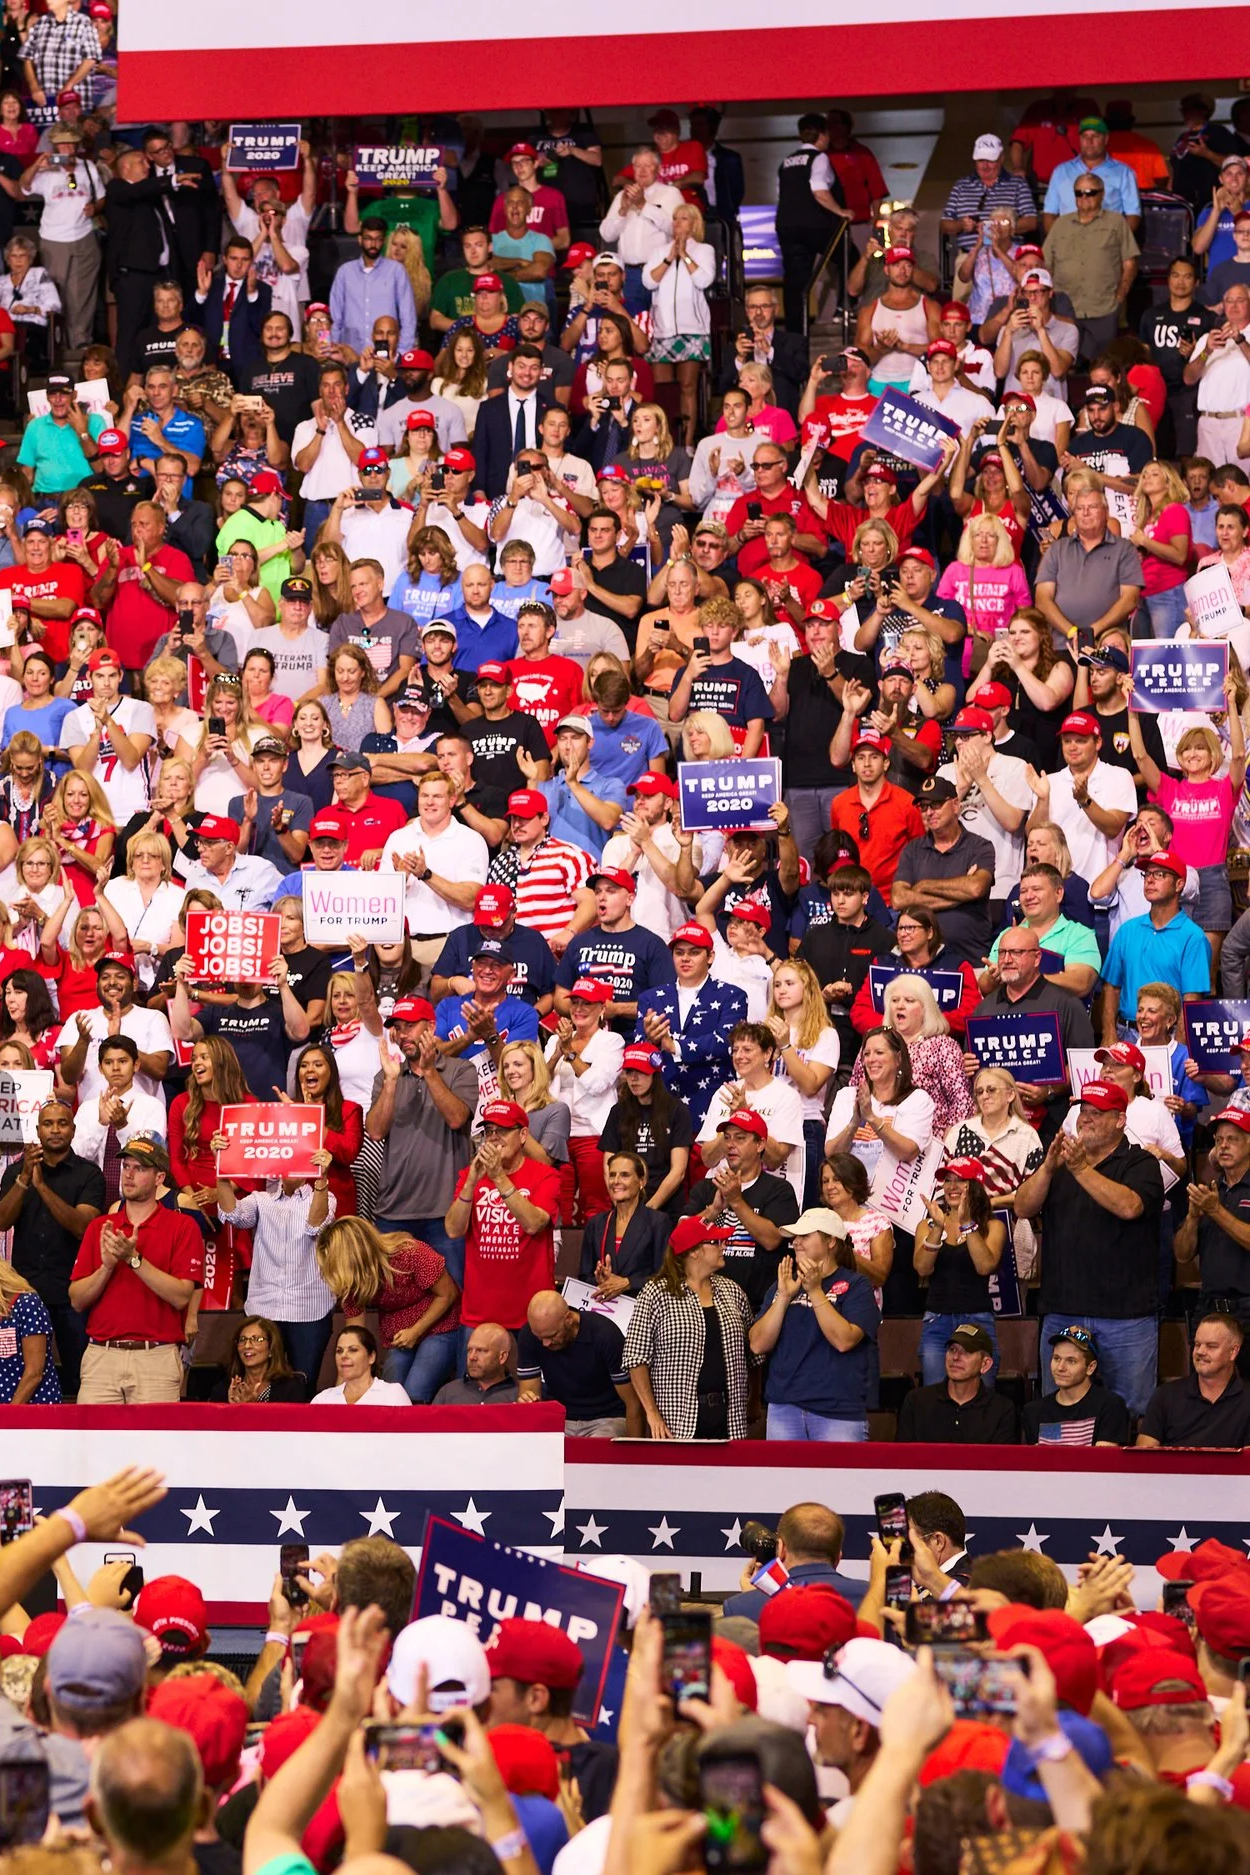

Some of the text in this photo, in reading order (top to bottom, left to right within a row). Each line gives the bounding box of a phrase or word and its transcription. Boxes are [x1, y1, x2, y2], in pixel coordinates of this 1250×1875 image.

[26, 106, 59, 116] TRU
[234, 136, 297, 147] TRUMP
[246, 151, 281, 160] 2020
[358, 148, 440, 165] TRUMP
[356, 164, 439, 173] KEEP AMERICA
[376, 172, 416, 180] GREAT!
[382, 179, 410, 187] 2020
[1154, 324, 1181, 349] US
[146, 341, 177, 351] TRUM
[881, 402, 949, 441] TRUMP
[881, 416, 938, 449] PENCE
[405, 589, 451, 602] TRUMP
[1201, 606, 1227, 623] TRUMP
[1137, 663, 1220, 678] TRUMP
[1144, 678, 1212, 688] PENCE
[471, 735, 517, 749] TRUMP
[101, 756, 118, 782] 7
[685, 773, 774, 793] TRUMP
[707, 797, 753, 813] 2020
[1175, 799, 1218, 814] TRUMP
[310, 891, 396, 914] Women
[200, 915, 265, 936] JOBS!
[320, 917, 389, 925] FOR TRUMP
[199, 936, 263, 957] JOBS!
[579, 948, 636, 967] Trump
[199, 957, 262, 978] JOBS!
[607, 975, 633, 990] 2020
[220, 1017, 270, 1028] TRUMP
[1192, 1021, 1250, 1036] TRU
[974, 1032, 1053, 1051] TRUMP
[1200, 1036, 1239, 1047] PEN
[982, 1047, 1047, 1062] PENCE
[476, 1061, 496, 1078] KEE
[225, 1121, 317, 1137] TRUMP
[244, 1146, 294, 1158] 2020
[880, 1159, 913, 1214] Wom
[902, 1196, 915, 1214] FOR
[481, 1224, 520, 1235] MAKE
[480, 1236, 520, 1245] AMERICA
[204, 1241, 217, 1290] 2020
[433, 1563, 599, 1645] TRUMP
